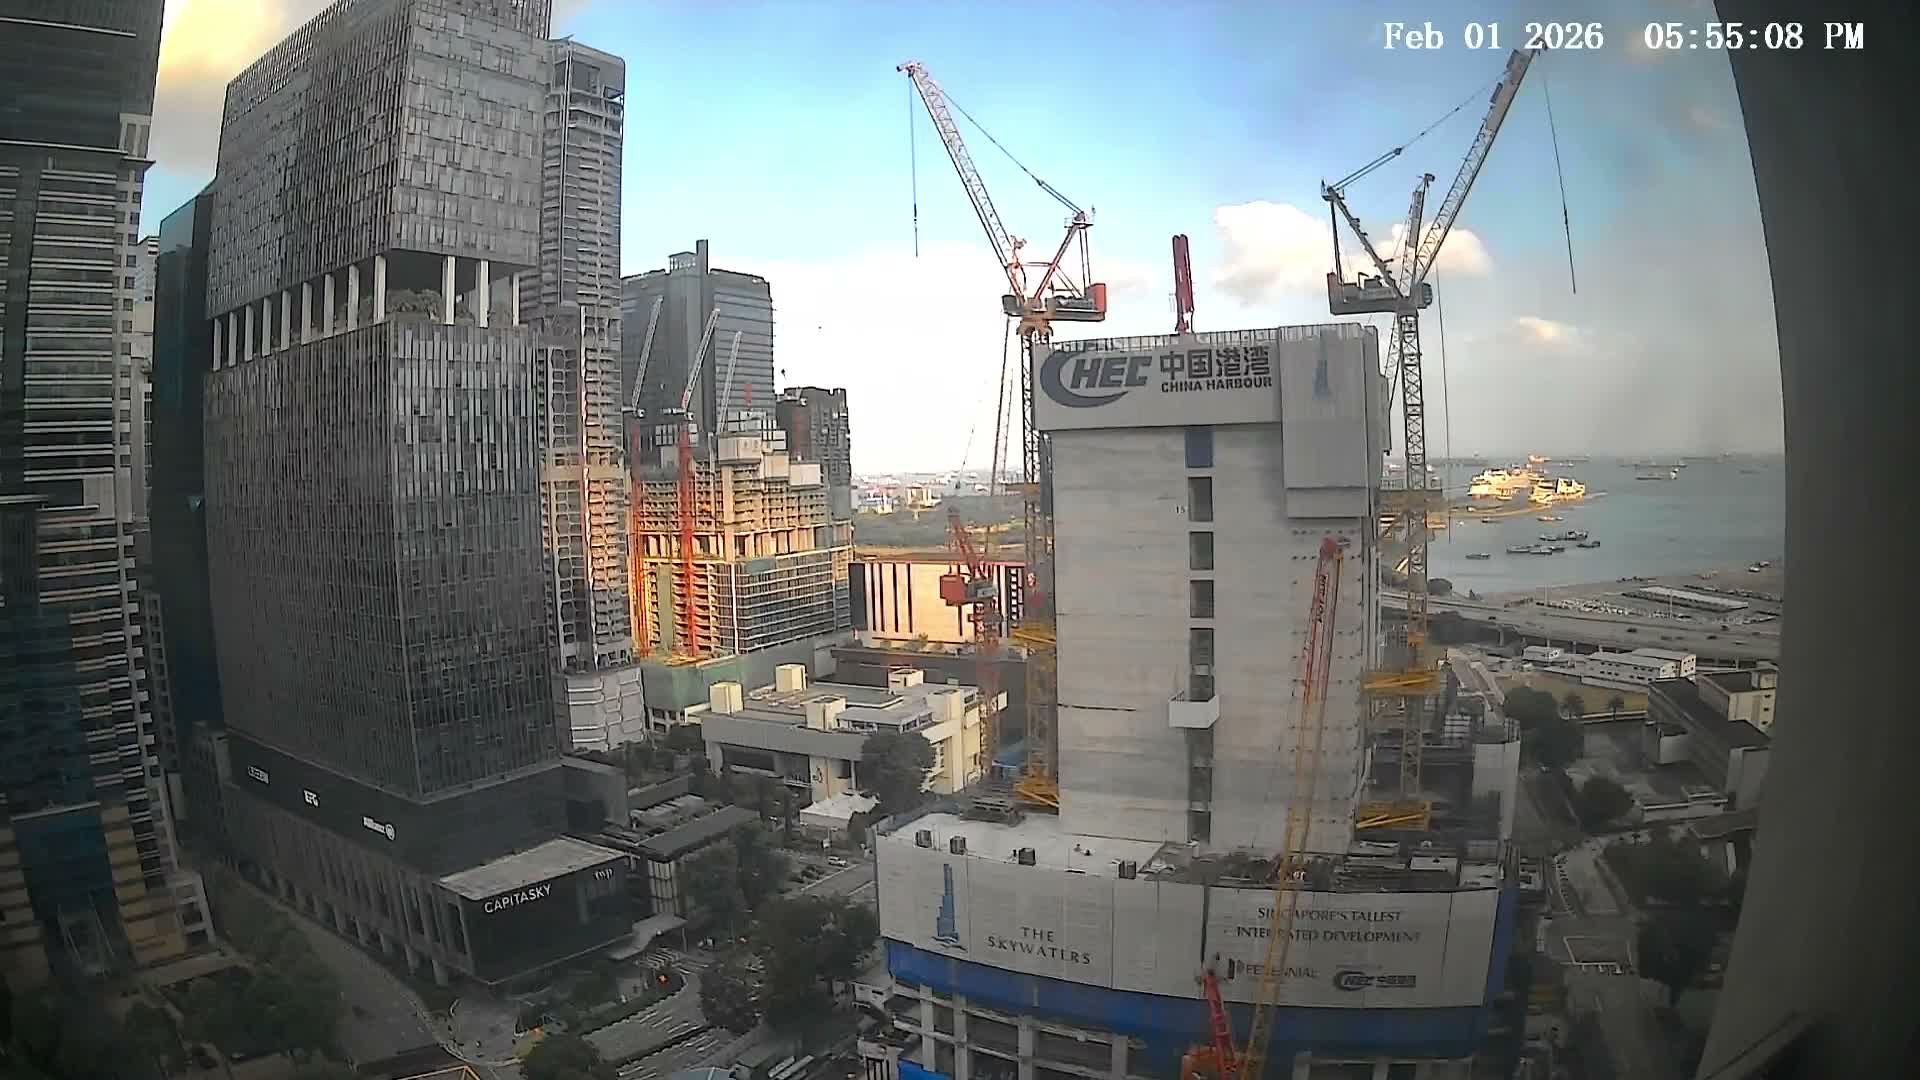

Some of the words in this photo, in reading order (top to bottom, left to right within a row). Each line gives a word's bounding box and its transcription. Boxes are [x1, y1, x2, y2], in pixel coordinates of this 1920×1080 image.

[1159, 346, 1270, 380] 中国港湾
[1161, 379, 1204, 393] CHINA
[1206, 376, 1272, 391] HARBOUR
[484, 883, 552, 913] CAPITASKY
[1351, 910, 1402, 923] TALLEST
[1020, 926, 1055, 942] THE
[1236, 926, 1319, 942] INTEATED
